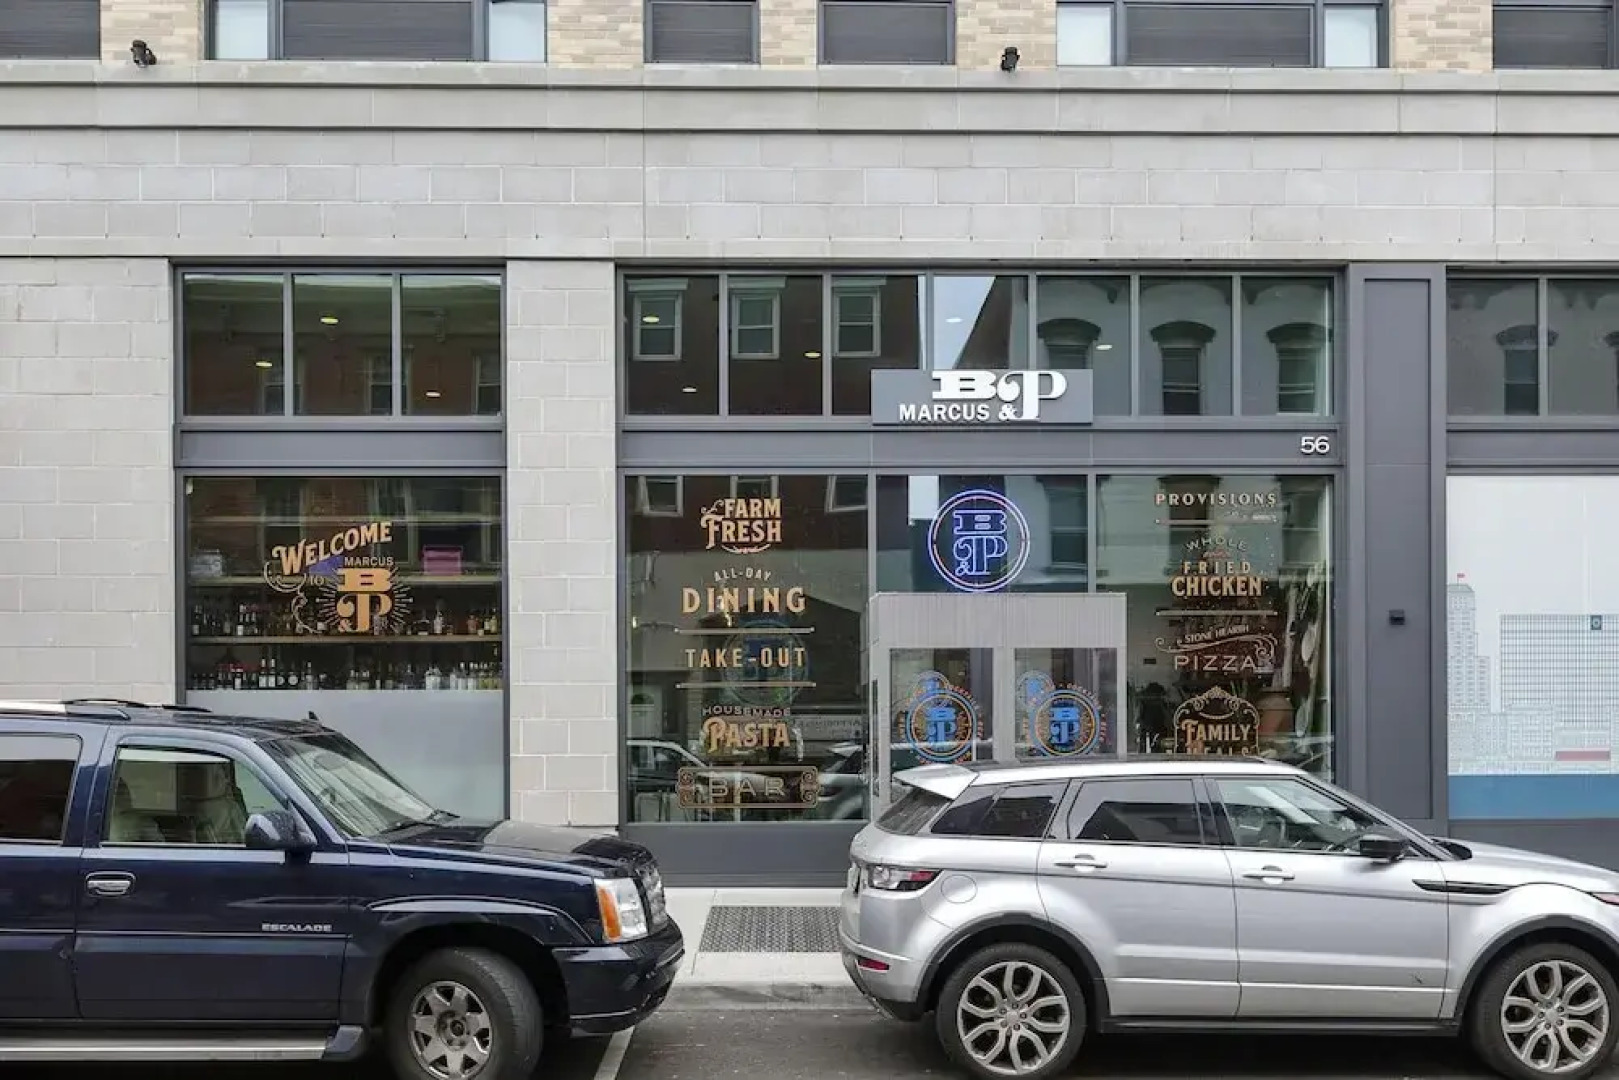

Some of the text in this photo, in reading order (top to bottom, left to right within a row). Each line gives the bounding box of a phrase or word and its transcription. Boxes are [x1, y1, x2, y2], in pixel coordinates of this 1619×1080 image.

[899, 403, 990, 420] MARCUS
[1300, 436, 1330, 454] 56
[723, 498, 781, 519] FARM
[1155, 493, 1277, 507] PROVISIONS
[701, 515, 782, 550] FRESH
[271, 522, 393, 576] WELCOME
[1186, 536, 1249, 552] WHOLE
[344, 556, 394, 567] MARCUS
[1184, 561, 1250, 575] FRIED
[713, 567, 772, 582] ALL-DAY
[1171, 575, 1262, 598] CHICKEN
[682, 586, 806, 613] DINING
[684, 647, 806, 668] TAKE-OUT
[1174, 655, 1257, 671] PIZZA
[702, 705, 791, 718] HOUSEMADE
[702, 716, 791, 754] PASTA
[1181, 719, 1251, 747] FAMILY
[709, 778, 786, 797] BAR
[261, 923, 333, 932] ESCALADE
